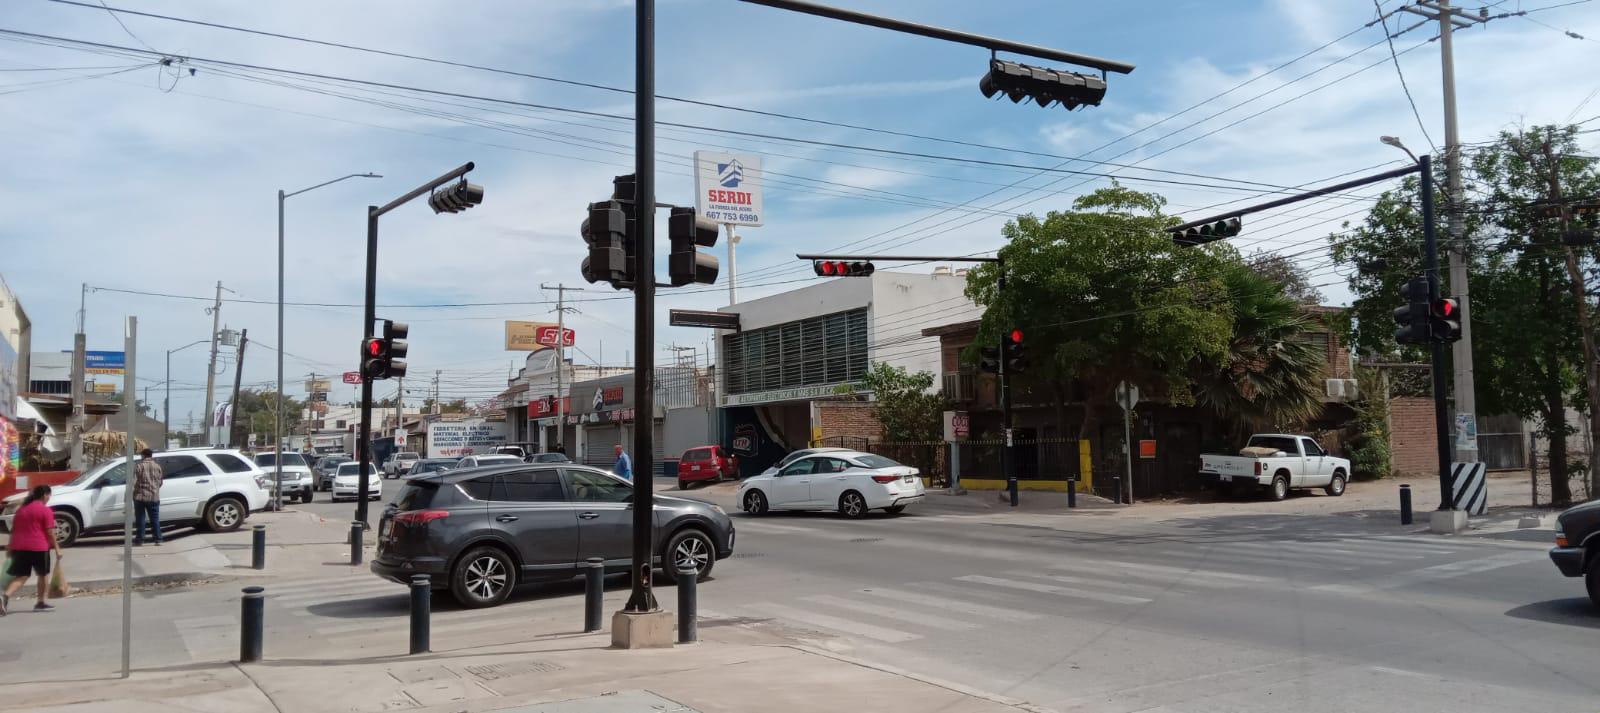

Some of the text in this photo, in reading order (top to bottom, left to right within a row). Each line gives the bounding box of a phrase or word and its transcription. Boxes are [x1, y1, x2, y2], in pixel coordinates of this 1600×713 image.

[708, 189, 752, 205] SERDI
[706, 211, 758, 222] 667 753 6990
